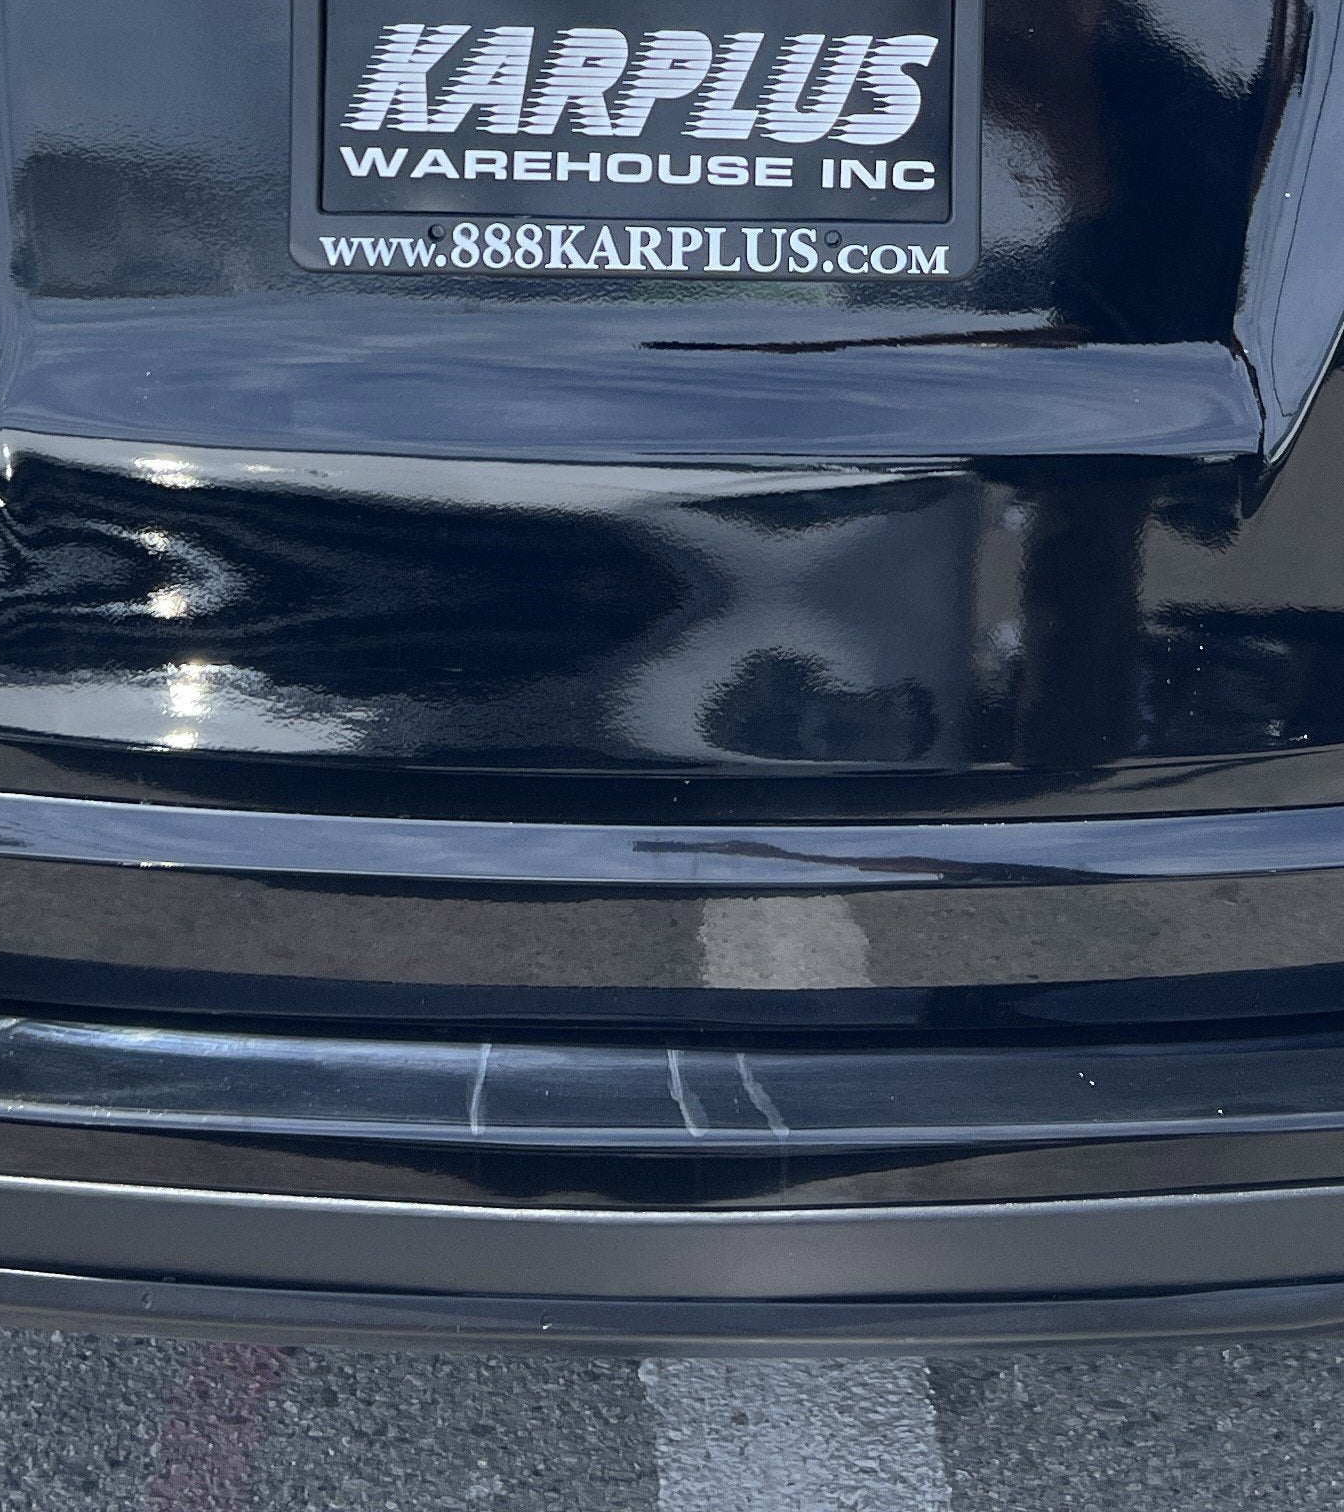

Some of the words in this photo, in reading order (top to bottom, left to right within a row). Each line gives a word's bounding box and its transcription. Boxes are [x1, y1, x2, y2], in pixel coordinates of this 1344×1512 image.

[340, 23, 940, 145] KARPLUS
[339, 146, 794, 188] WAREHOUSE
[821, 158, 936, 191] INC
